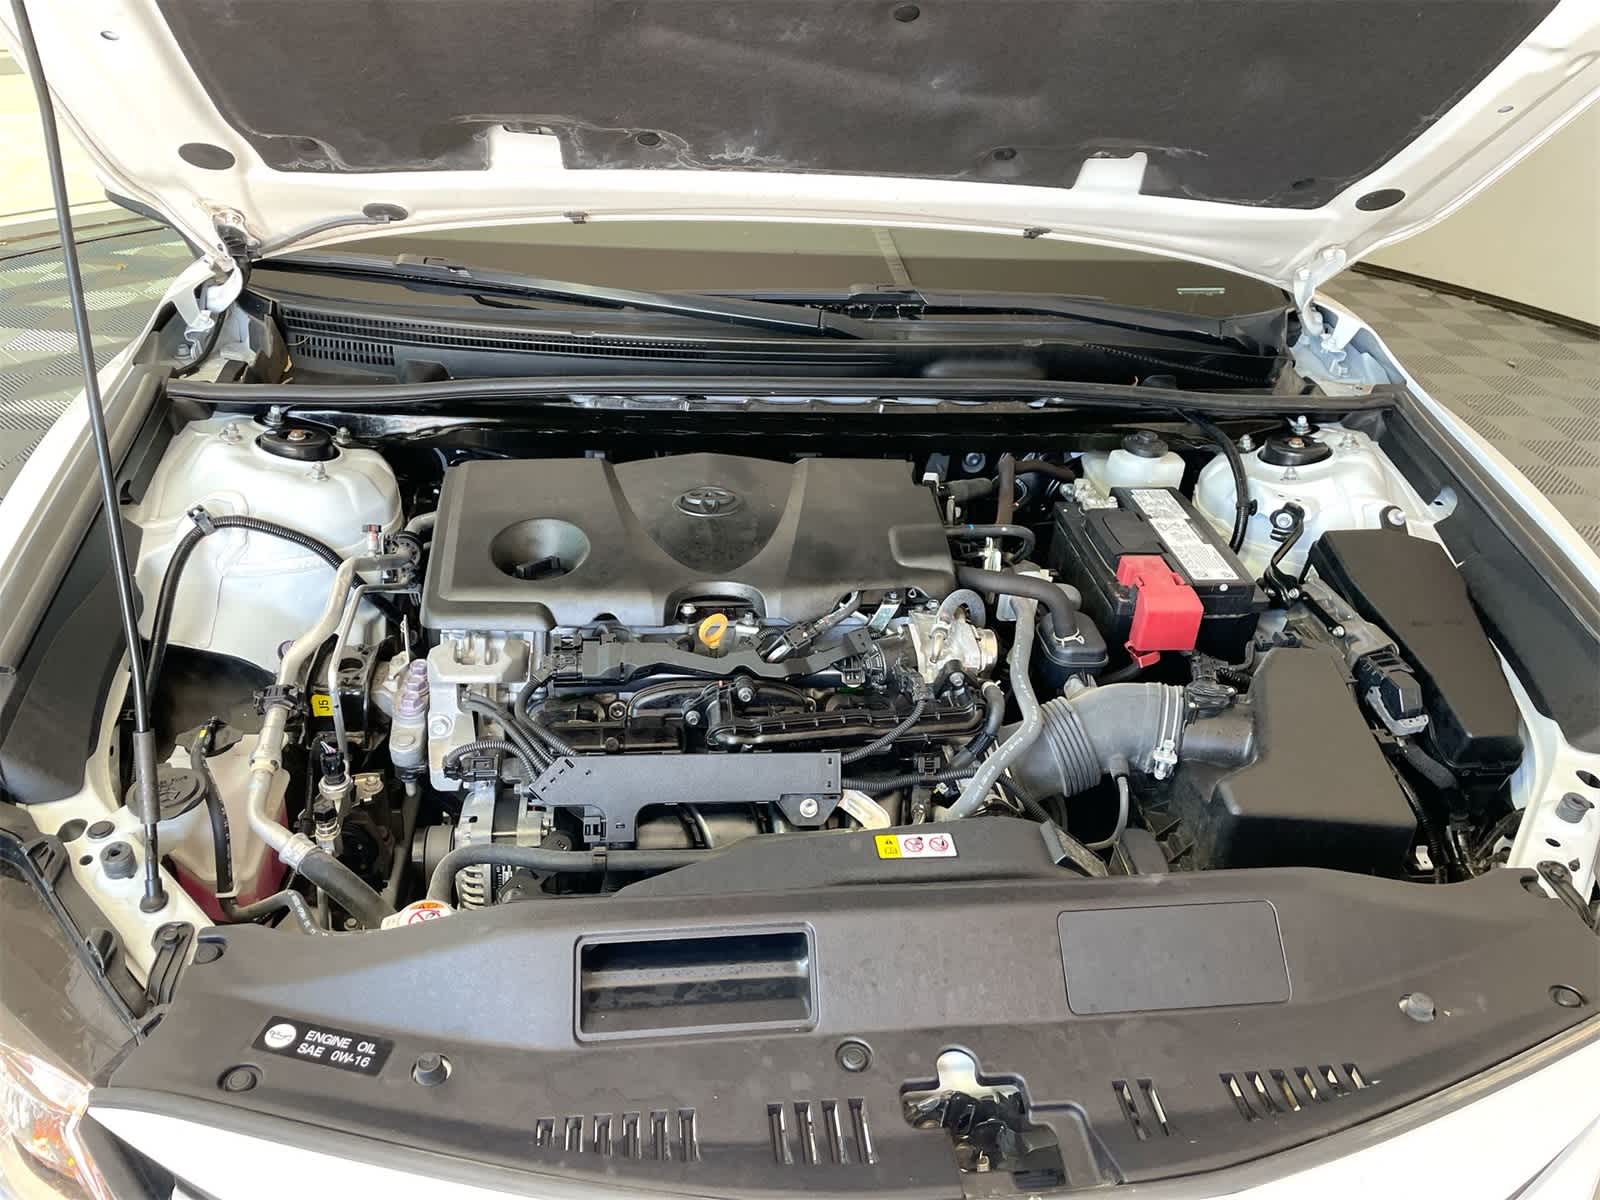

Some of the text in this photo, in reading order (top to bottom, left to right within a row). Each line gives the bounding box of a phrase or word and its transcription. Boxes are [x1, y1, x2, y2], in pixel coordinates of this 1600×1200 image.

[304, 1030, 376, 1054] ENGINE OIL
[297, 1043, 371, 1067] SAE 0W-16
